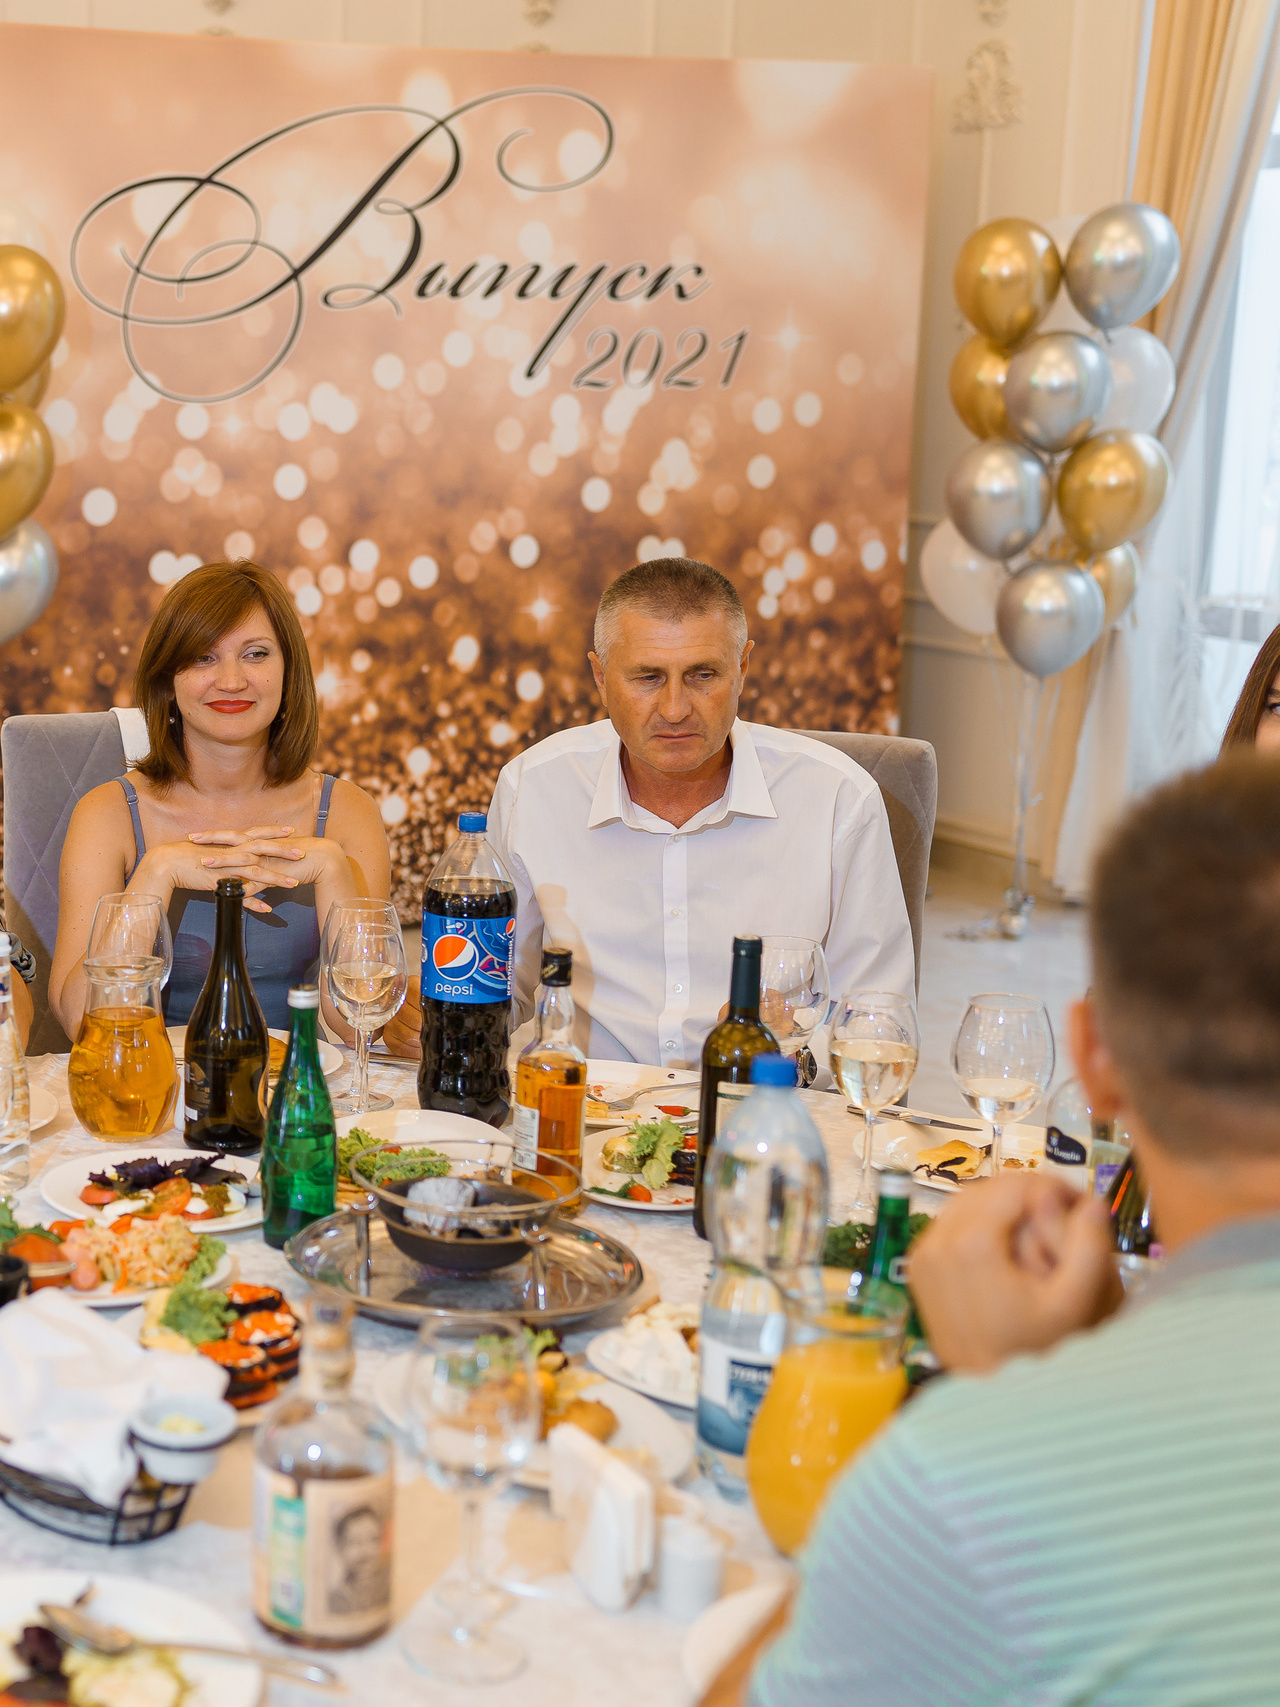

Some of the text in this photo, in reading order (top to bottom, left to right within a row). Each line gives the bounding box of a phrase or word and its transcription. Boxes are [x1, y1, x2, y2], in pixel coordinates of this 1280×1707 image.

[71, 86, 712, 403] Выпуск
[572, 326, 750, 391] 2021
[434, 982, 474, 997] pepsi
